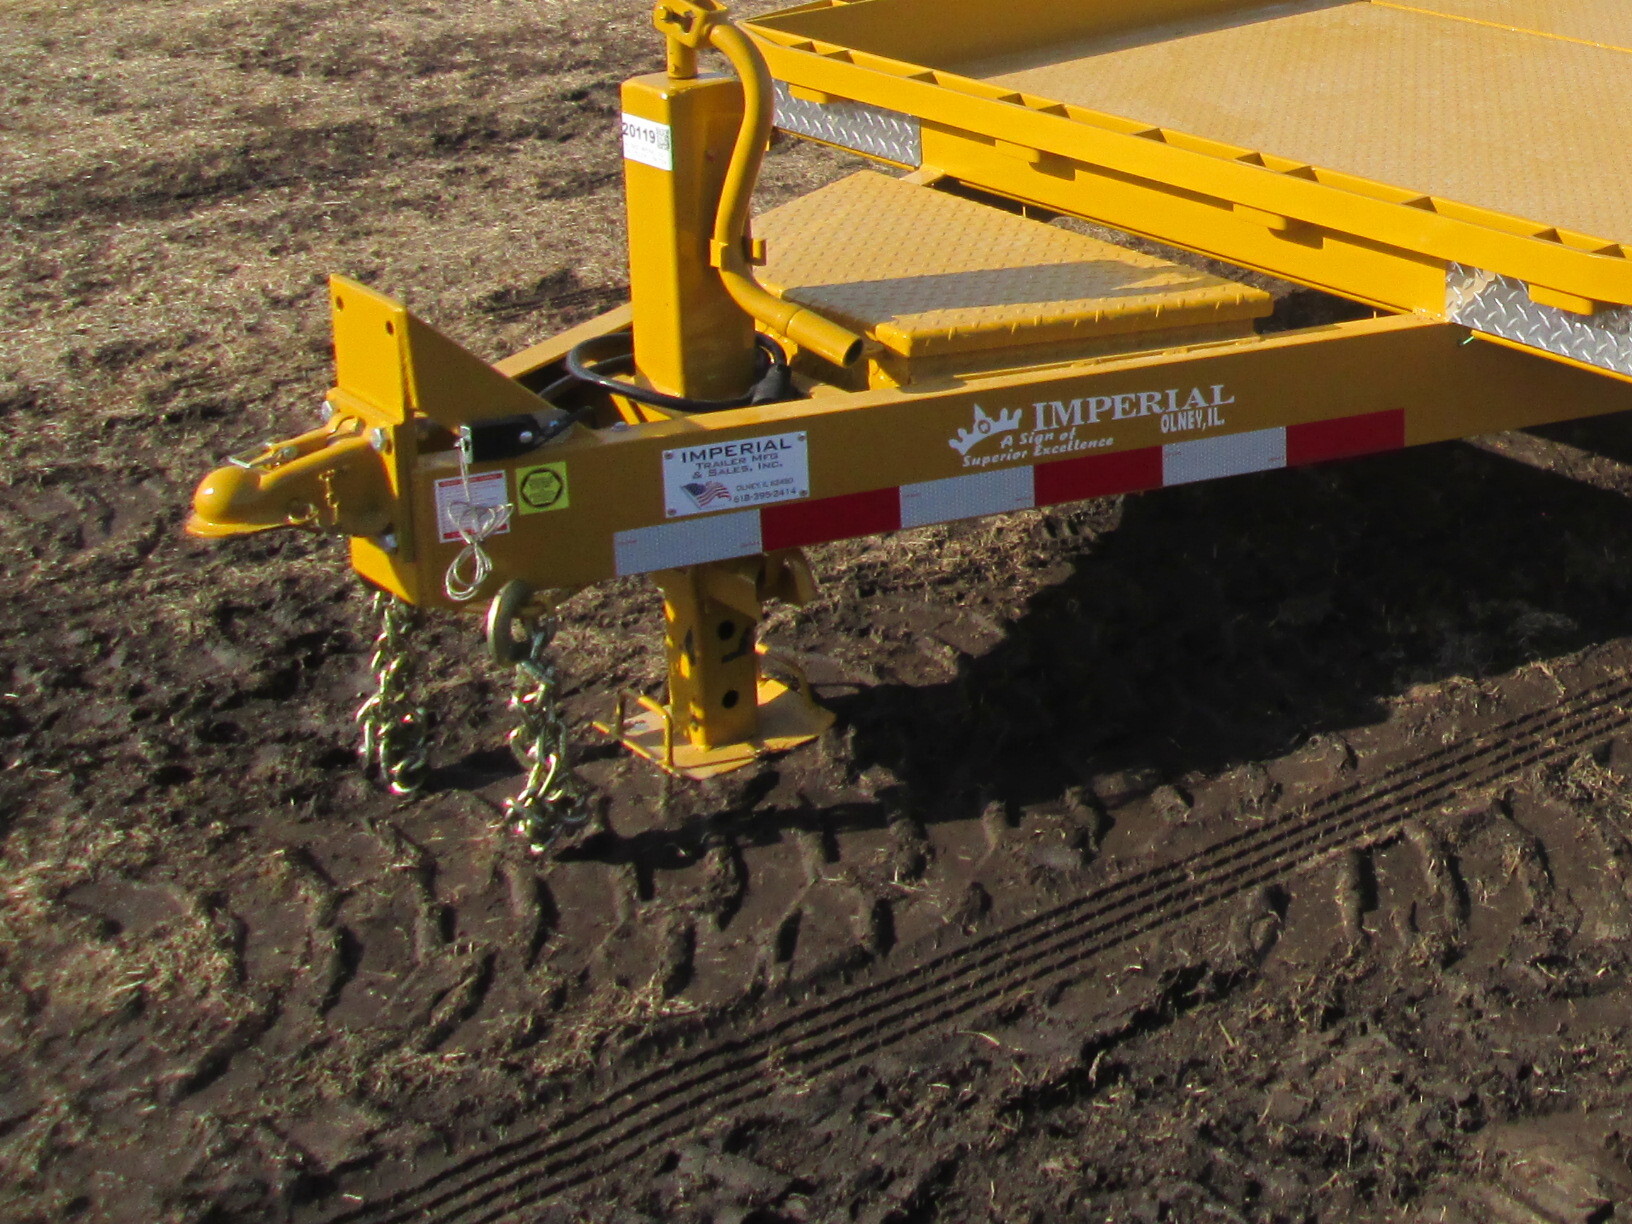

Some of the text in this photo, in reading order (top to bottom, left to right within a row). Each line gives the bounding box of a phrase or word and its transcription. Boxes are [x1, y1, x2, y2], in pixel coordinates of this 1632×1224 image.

[1032, 384, 1235, 431] IMPERIAL
[682, 438, 792, 464] IMPERIAL
[962, 436, 1114, 467] Superior Excellence
[1000, 426, 1077, 449] A Sign of
